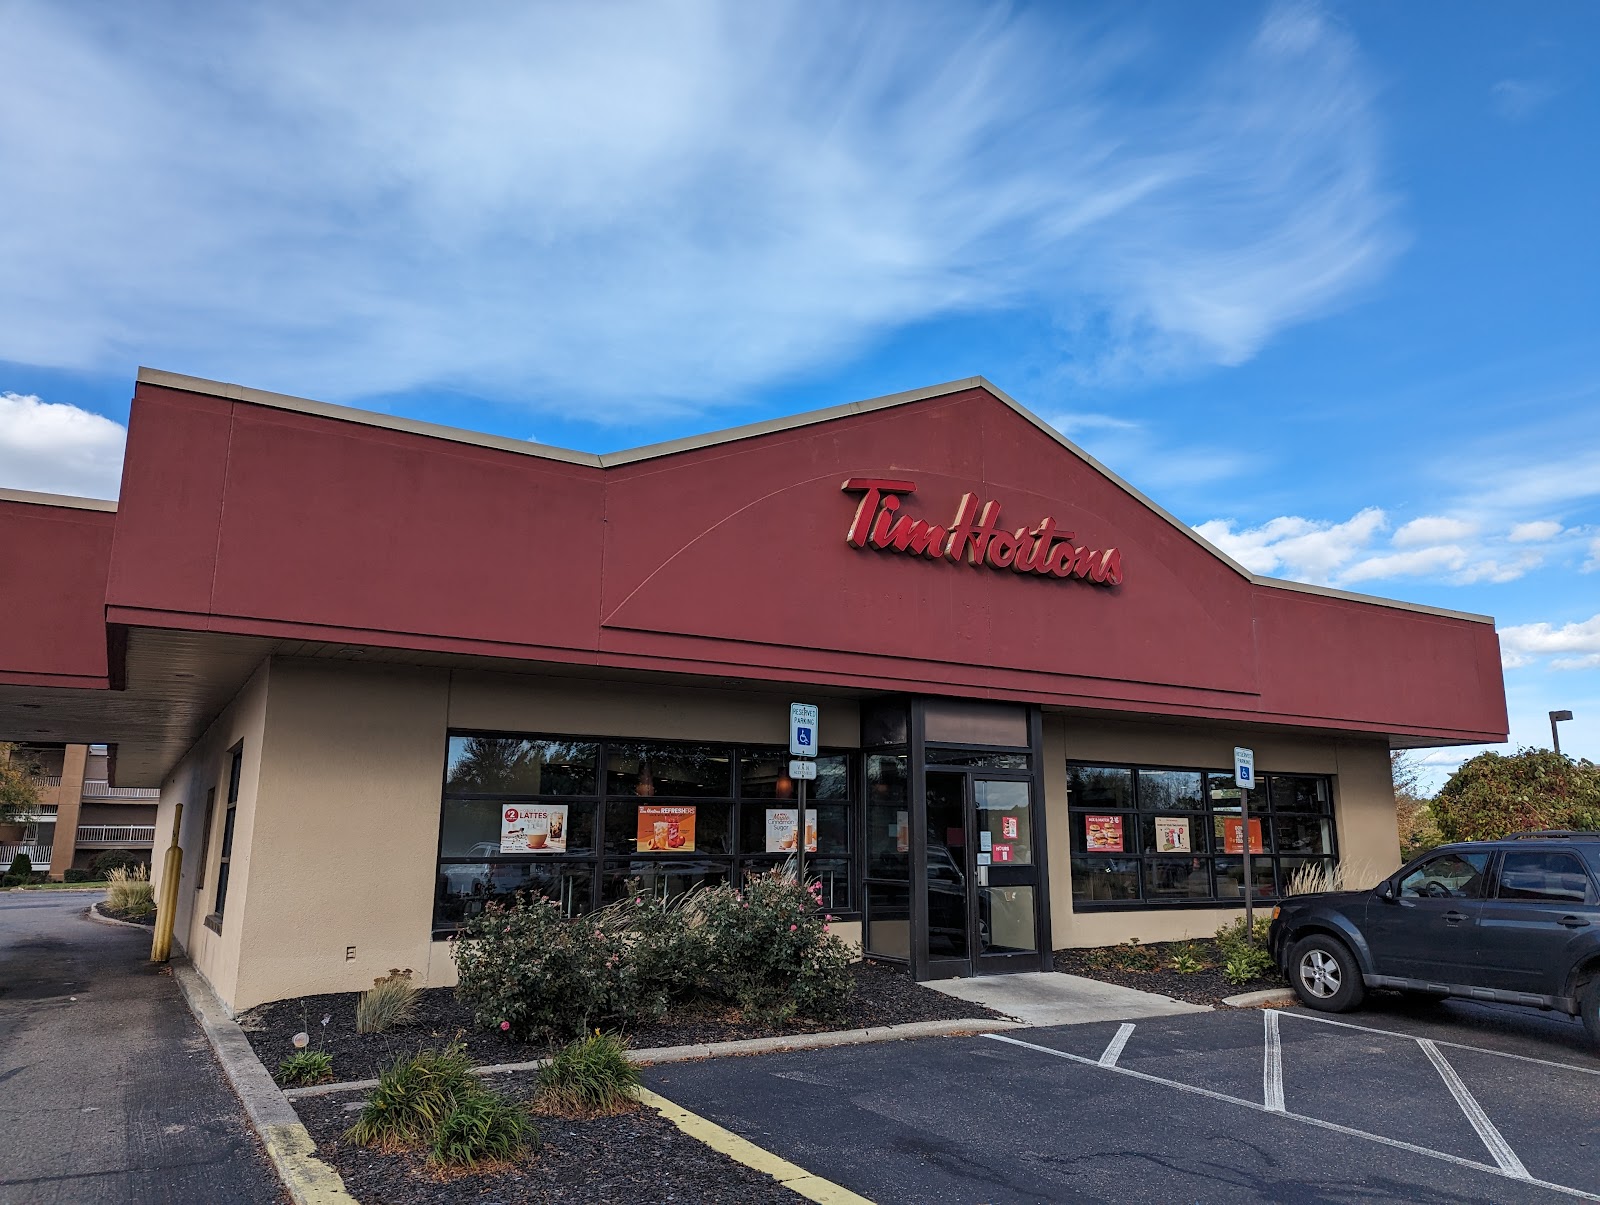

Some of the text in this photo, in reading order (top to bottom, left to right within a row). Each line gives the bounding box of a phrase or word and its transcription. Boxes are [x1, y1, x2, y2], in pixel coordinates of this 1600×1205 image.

[840, 477, 1123, 586] Tim Hortons
[792, 707, 816, 718] RESERVED
[794, 716, 815, 726] PARKING
